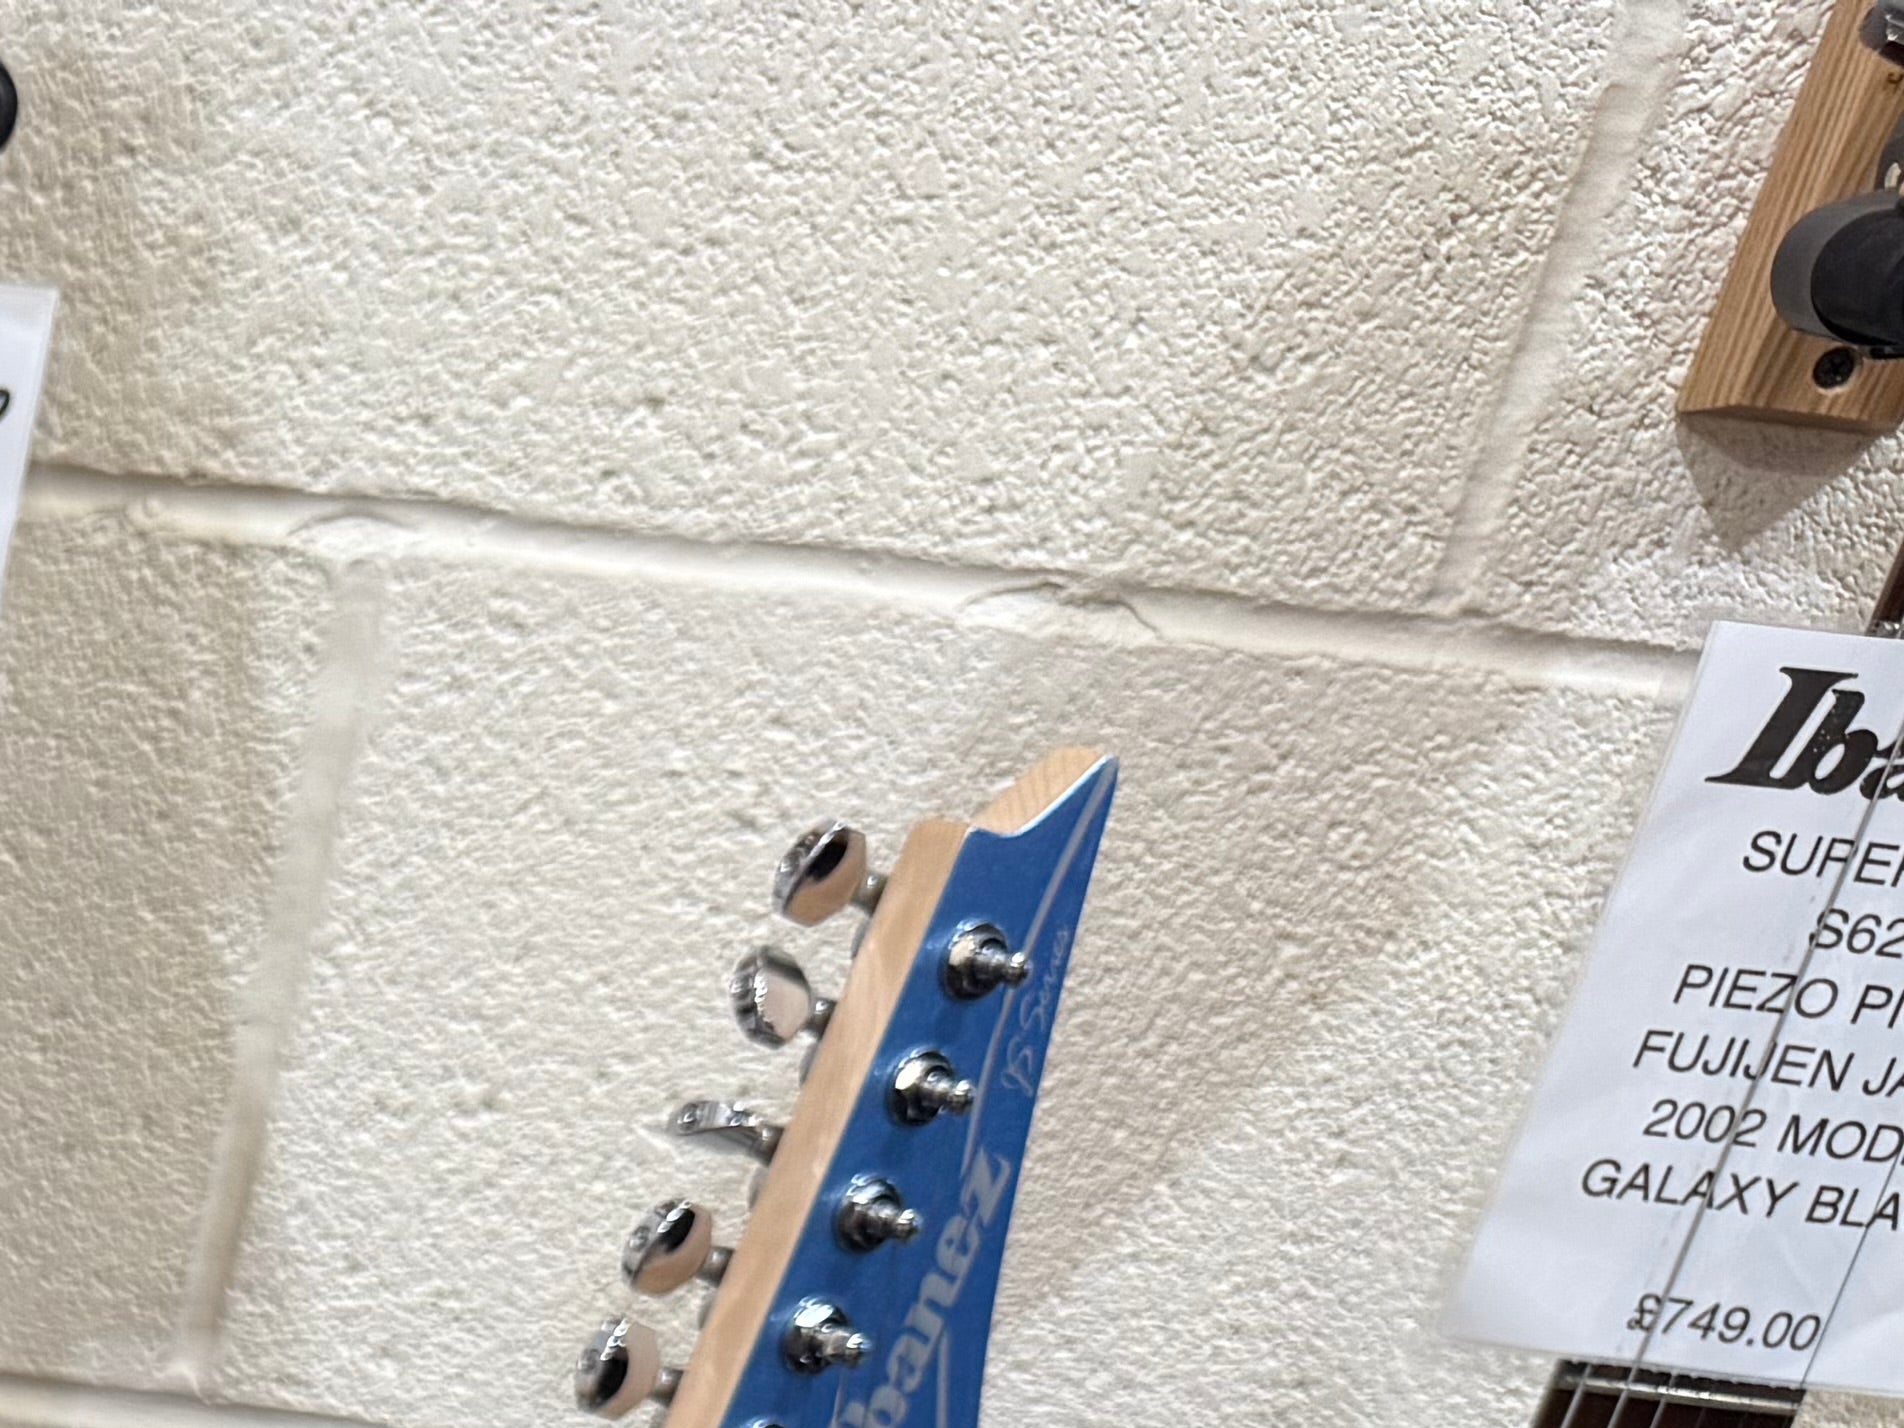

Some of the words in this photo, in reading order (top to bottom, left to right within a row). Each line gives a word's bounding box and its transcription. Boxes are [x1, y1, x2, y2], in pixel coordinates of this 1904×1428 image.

[1673, 964, 1839, 1019] PIEZO
[1633, 1030, 1855, 1091] FUJIJEN
[1643, 1099, 1767, 1147] 2002
[1776, 1114, 1904, 1166] MOD
[1581, 1159, 1799, 1218] GALAXY
[1626, 1293, 1821, 1351] £749.00
